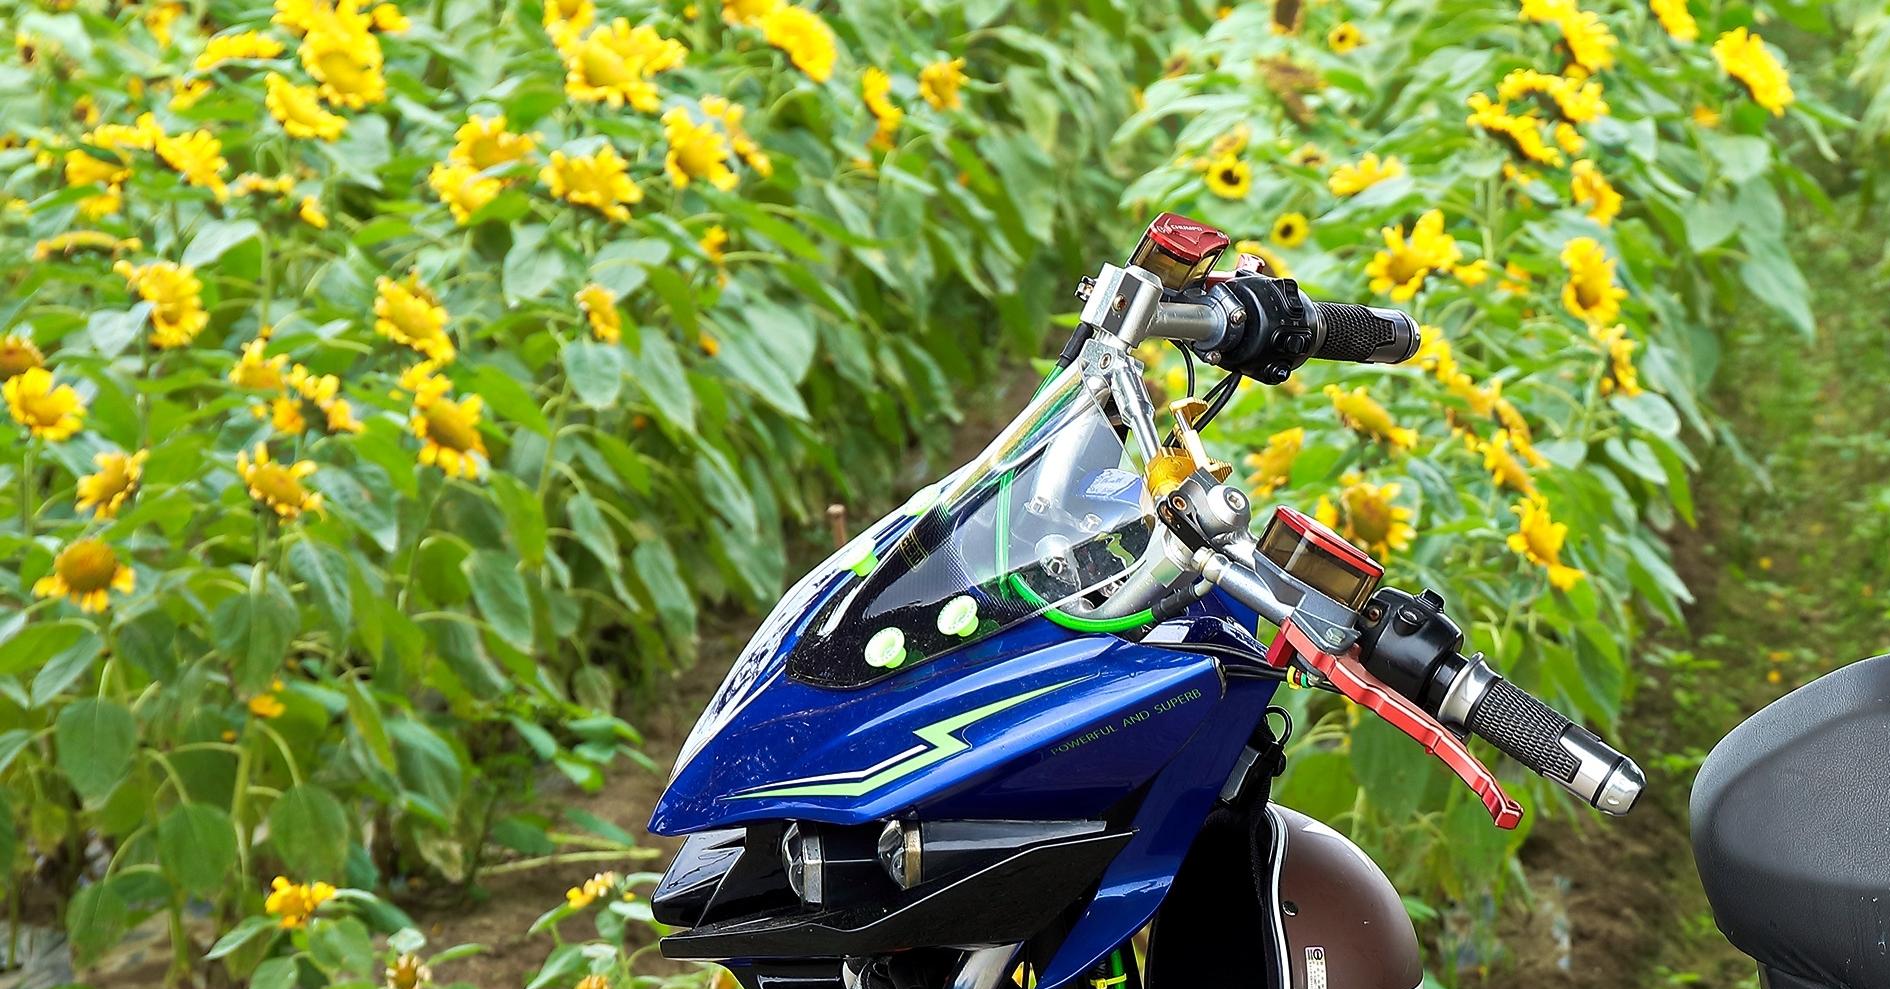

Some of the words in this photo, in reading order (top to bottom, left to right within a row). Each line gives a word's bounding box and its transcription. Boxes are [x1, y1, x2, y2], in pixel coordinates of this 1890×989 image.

[1050, 724, 1117, 756] POWERFUL
[1122, 710, 1150, 728] AND
[1153, 688, 1202, 714] SUPERB
